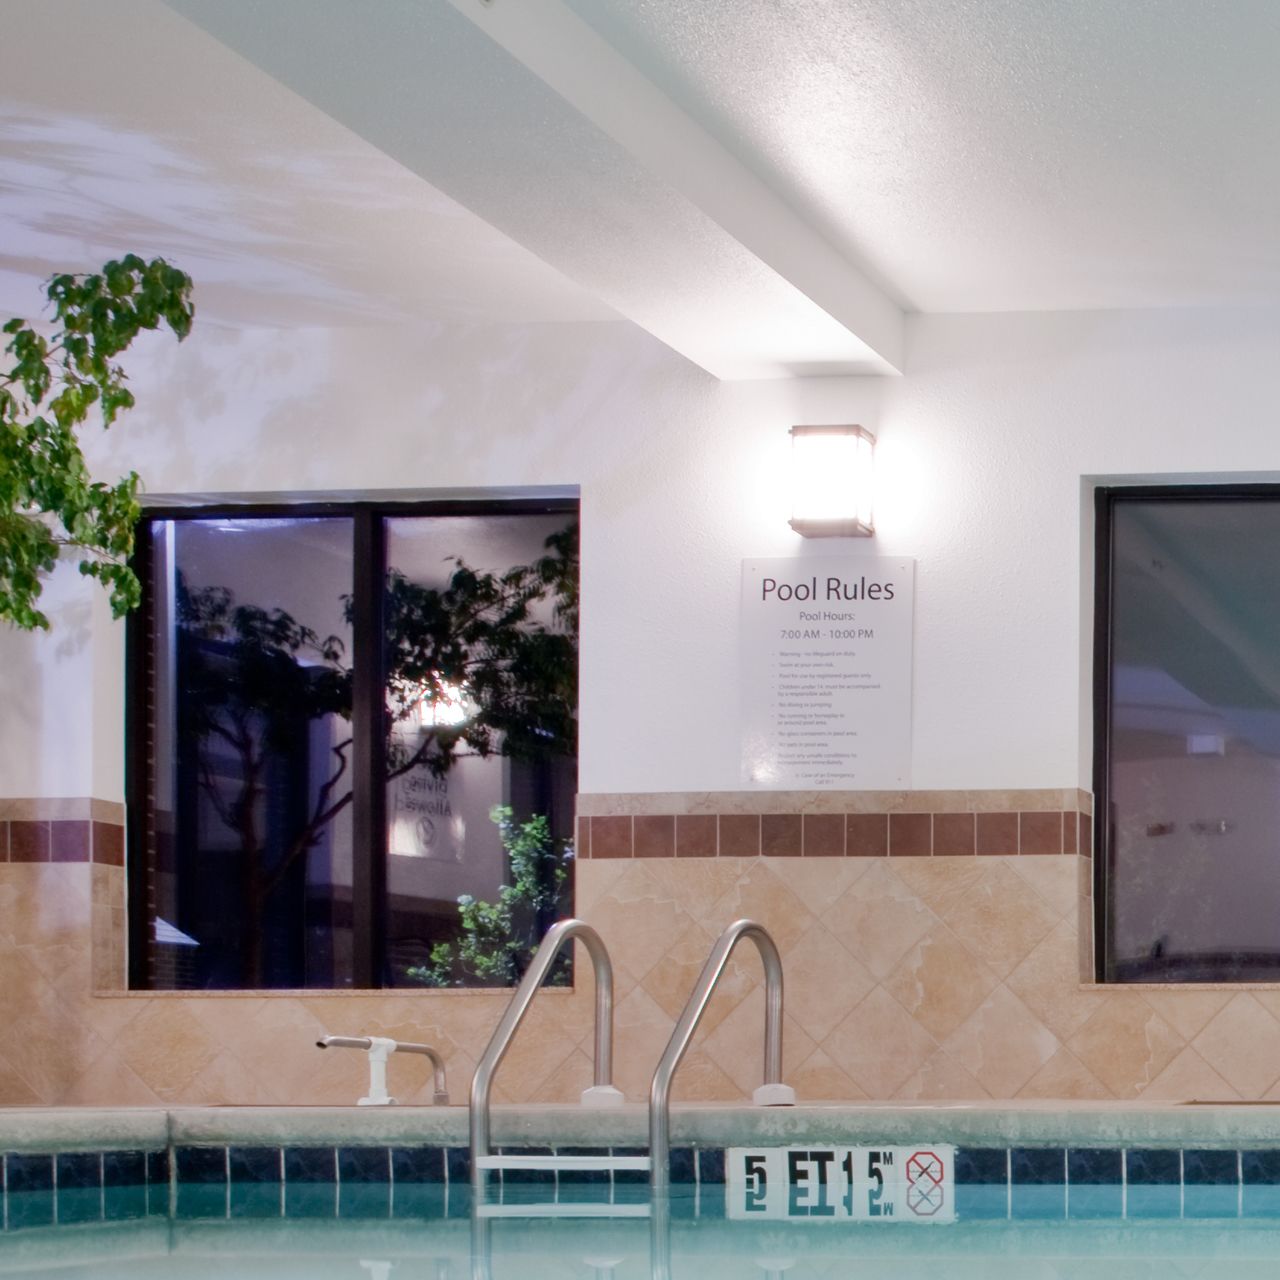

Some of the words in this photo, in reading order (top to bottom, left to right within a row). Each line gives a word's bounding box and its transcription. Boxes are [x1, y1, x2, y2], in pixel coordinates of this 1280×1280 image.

[762, 576, 817, 601] Pool
[826, 576, 895, 601] Rules
[799, 611, 821, 621] Pool
[823, 611, 856, 621] Hours:
[781, 629, 800, 639] 7:00
[803, 629, 820, 639] AM
[829, 629, 856, 639] 10:00
[858, 629, 874, 639] PM
